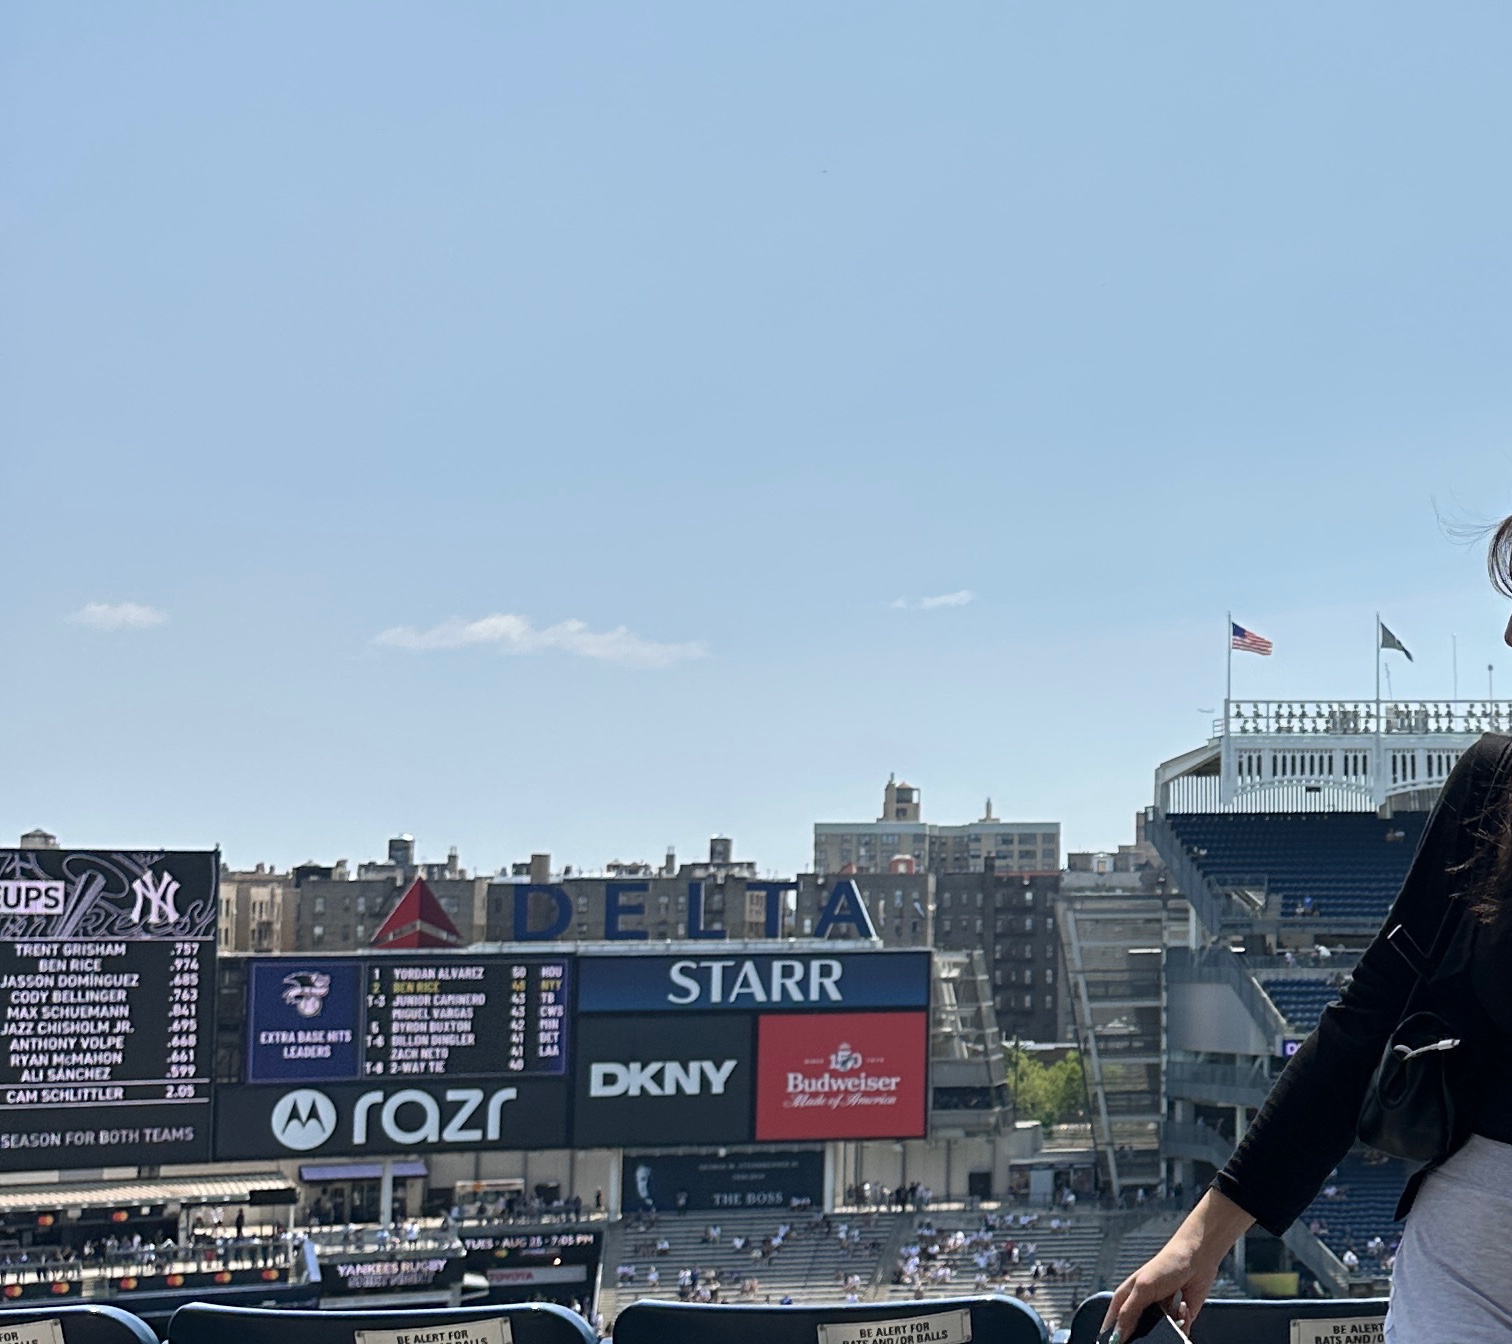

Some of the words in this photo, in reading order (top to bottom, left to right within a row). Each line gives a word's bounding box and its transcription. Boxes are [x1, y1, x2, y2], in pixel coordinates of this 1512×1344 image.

[0, 886, 60, 909] UPS
[513, 879, 879, 941] DELTA
[15, 943, 60, 957] TRENT
[62, 943, 126, 956] GRISHAM
[39, 958, 67, 972] BEN
[70, 958, 102, 972] RICE
[374, 968, 380, 980] 1
[437, 966, 485, 980] ALVAREZ
[0, 974, 54, 988] JASSON
[667, 959, 844, 1004] STARR
[11, 990, 49, 1004] CODY
[52, 989, 127, 1003] BELLINGER
[541, 992, 555, 1004] TB
[7, 1006, 38, 1019] MAX
[0, 1022, 35, 1036] JAZZ
[37, 1020, 110, 1035] CHISHOLM
[113, 1020, 135, 1033] JR.
[9, 1036, 77, 1051] ANTHONY
[80, 1036, 125, 1049] VOLPE
[259, 1031, 295, 1045] EXTRA
[298, 1030, 326, 1044] BASE
[327, 1029, 352, 1043] HITS
[283, 1045, 332, 1059] LEADERS
[10, 1053, 49, 1067] RYAN
[21, 1068, 44, 1082] ALI
[590, 1060, 737, 1098] DKNY
[786, 1072, 901, 1093] Budweiser
[6, 1089, 38, 1103] CAM
[41, 1087, 124, 1102] SCHLITTLER
[783, 1094, 827, 1109] Made
[828, 1095, 841, 1110] of
[841, 1093, 897, 1107] America
[352, 1088, 517, 1145] razr
[0, 1132, 62, 1149] SEASON
[65, 1131, 96, 1147] FOR
[99, 1128, 140, 1145] BOTH
[143, 1126, 195, 1143] TEAMS
[713, 1192, 743, 1206] THE
[745, 1191, 784, 1206] BOSS
[464, 1238, 494, 1250] TUES
[502, 1236, 527, 1248] AUG
[576, 1234, 594, 1245] PM
[337, 1261, 399, 1277] YANKEES
[400, 1259, 447, 1273] RUGBY
[859, 1329, 873, 1339] BE
[875, 1325, 908, 1337] ALERT
[910, 1322, 930, 1333] FOR
[1333, 1325, 1347, 1335] BE
[1350, 1323, 1385, 1334] ALERT
[397, 1335, 410, 1344] BE
[413, 1332, 445, 1344] ALERT
[448, 1330, 469, 1340] FOR
[916, 1330, 949, 1344] BALLS
[1345, 1334, 1385, 1344] AND/O
